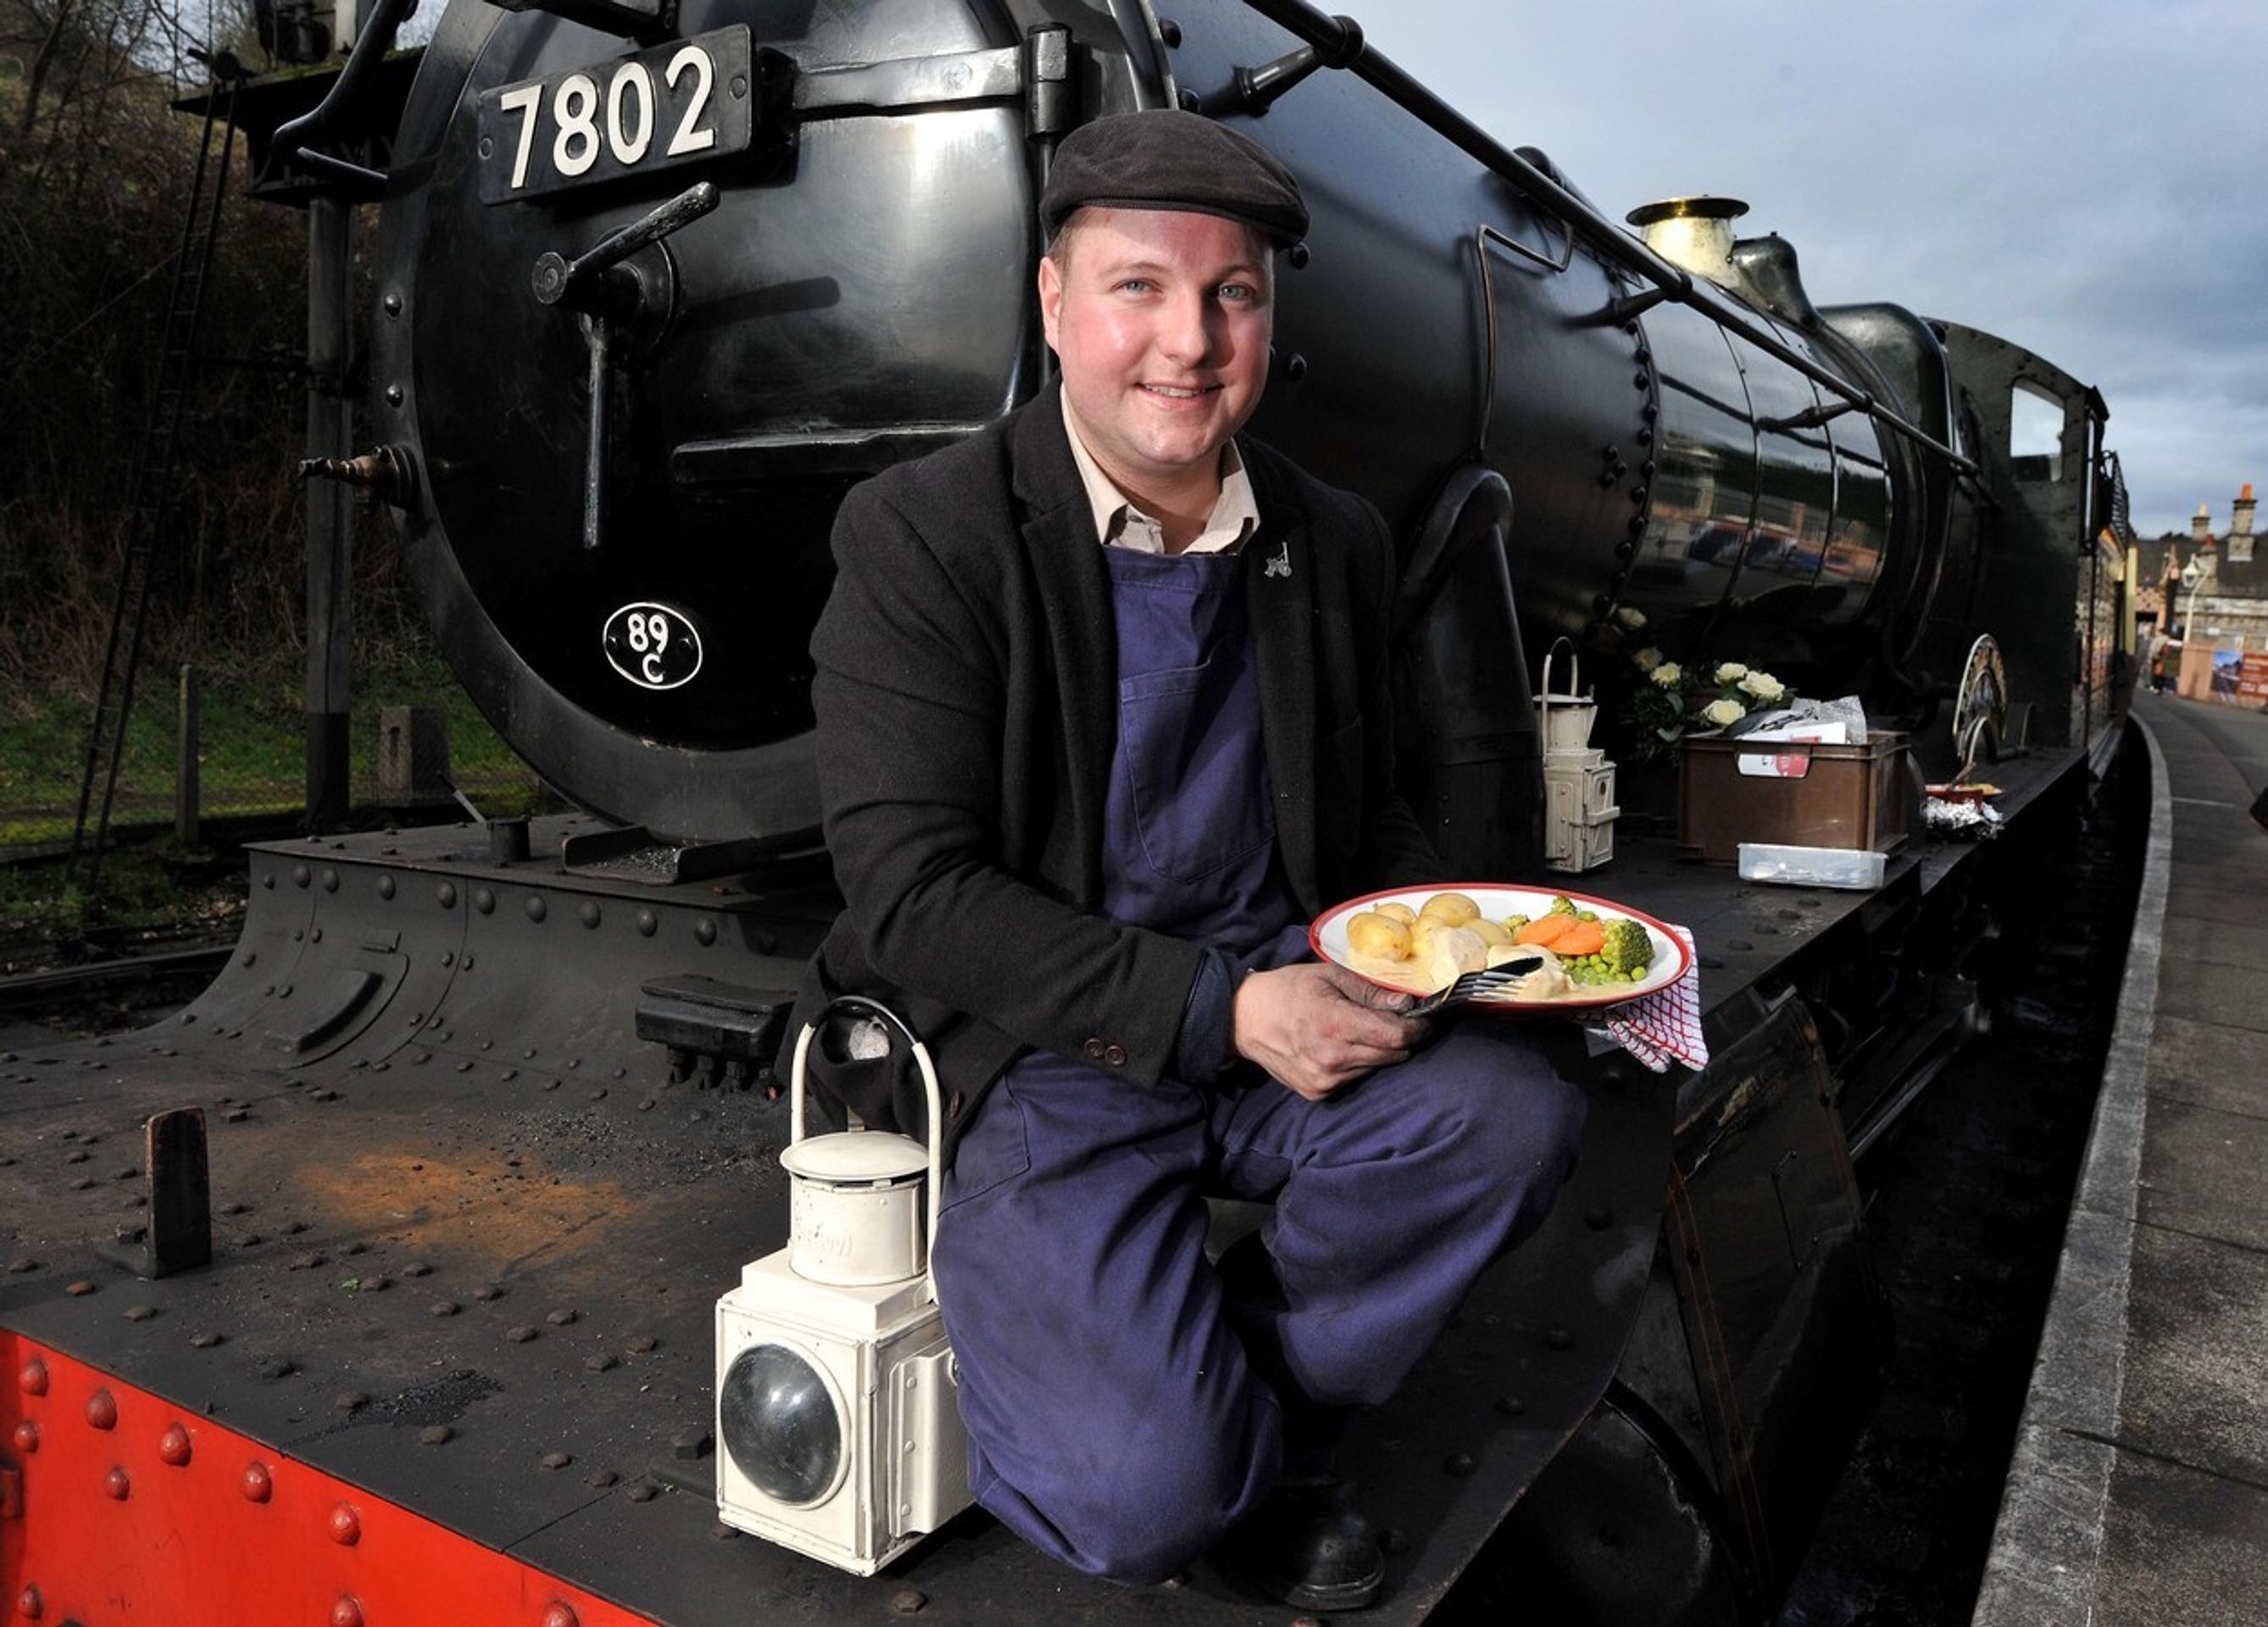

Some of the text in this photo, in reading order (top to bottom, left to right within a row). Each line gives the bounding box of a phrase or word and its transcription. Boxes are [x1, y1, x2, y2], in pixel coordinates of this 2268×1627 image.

[501, 45, 716, 189] 7802
[627, 613, 669, 654] 89
[642, 652, 664, 683] C
